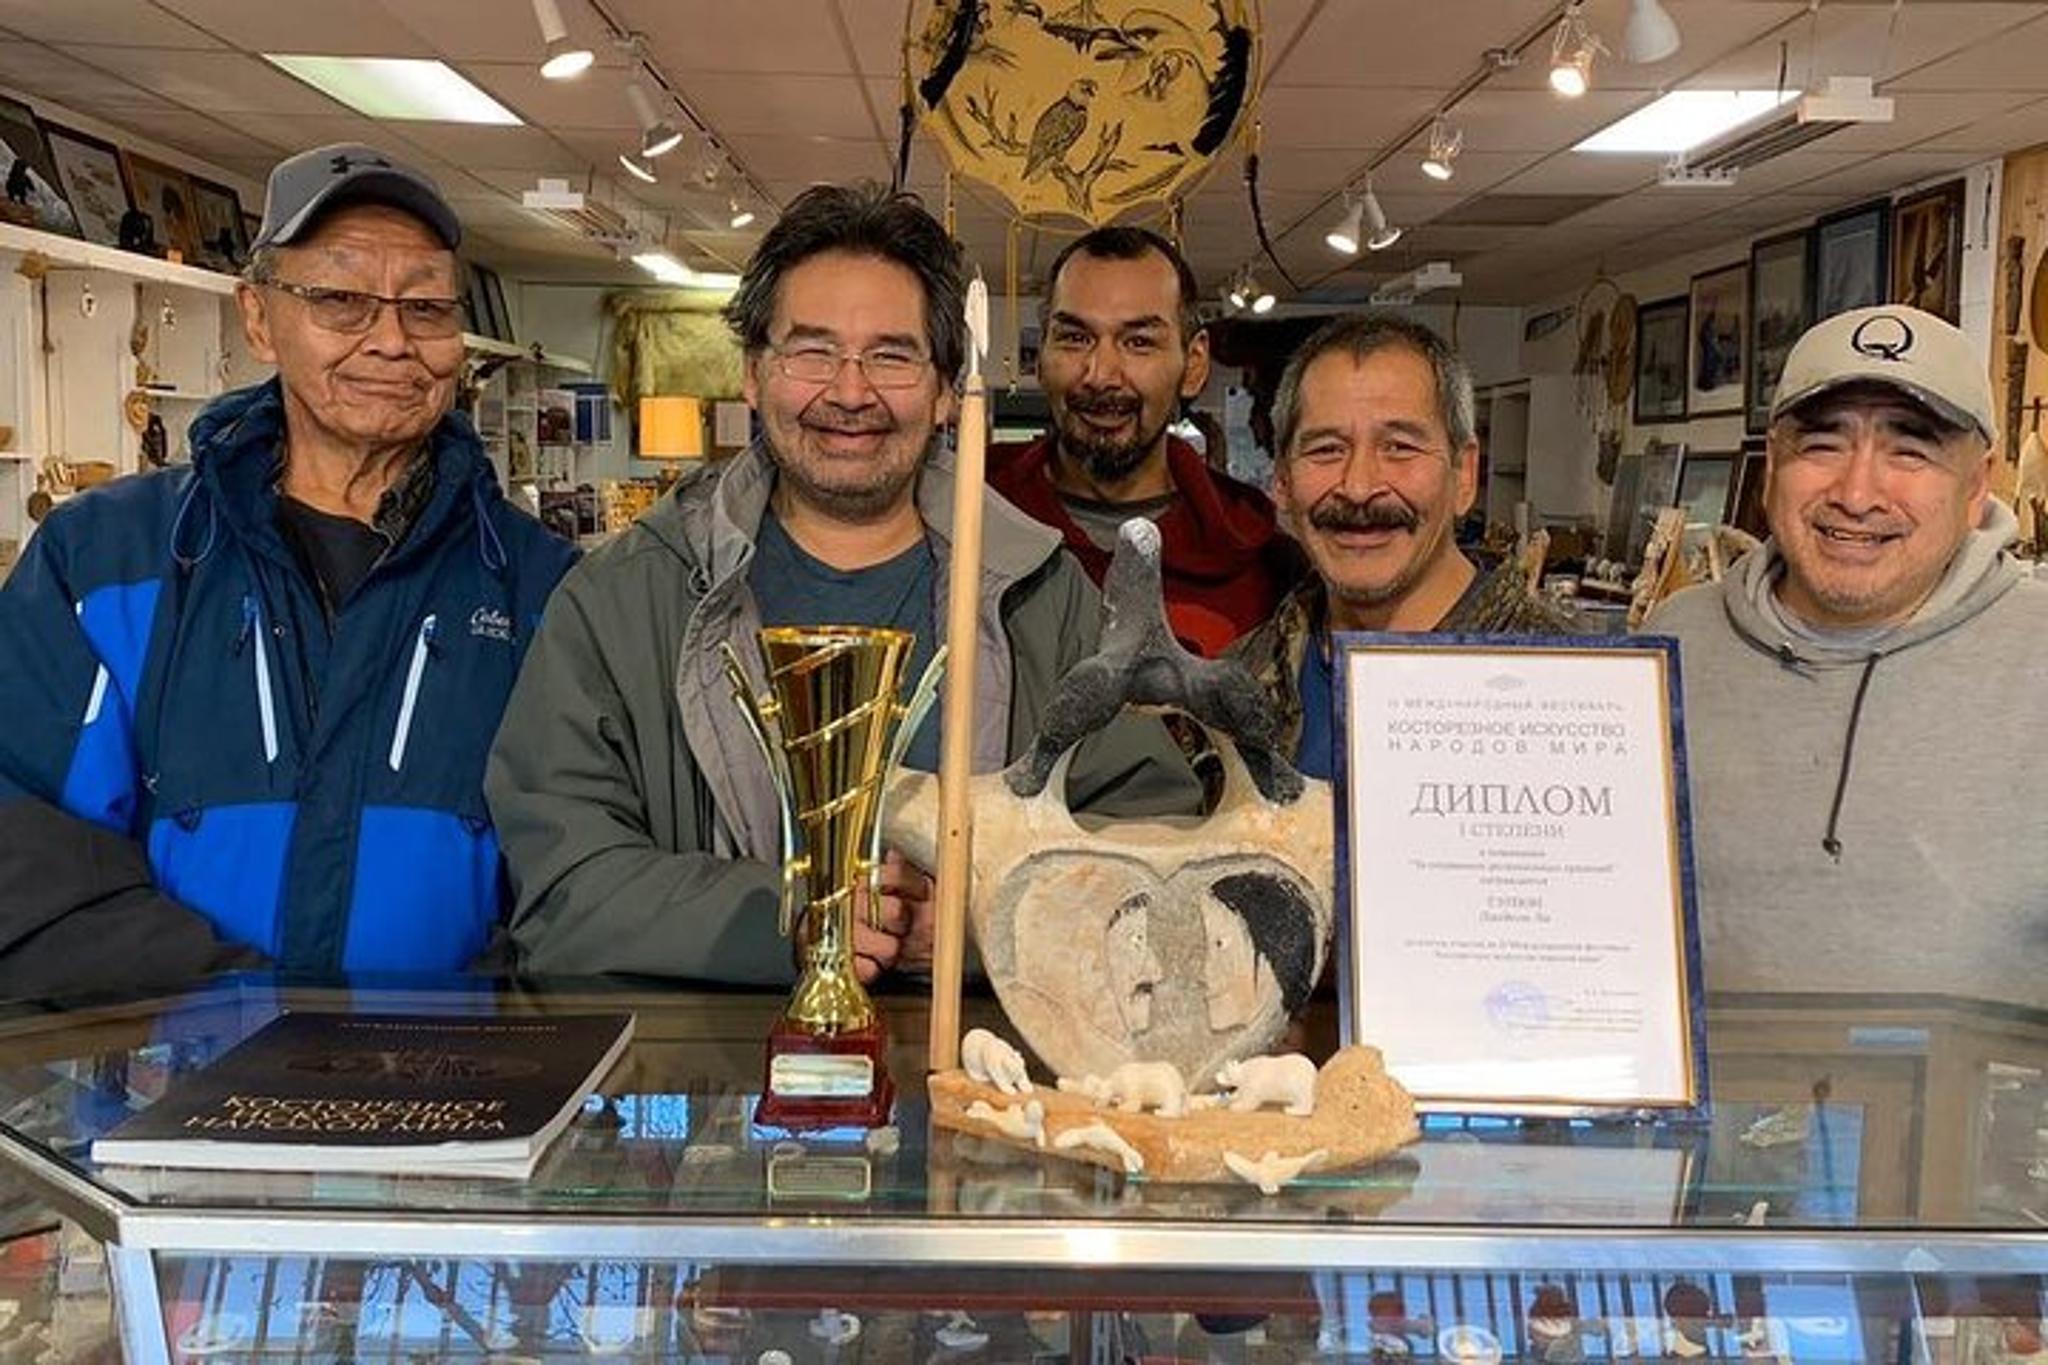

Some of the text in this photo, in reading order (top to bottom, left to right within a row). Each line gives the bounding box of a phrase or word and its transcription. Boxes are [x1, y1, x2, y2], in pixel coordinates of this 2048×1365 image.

[1388, 720, 1626, 737] КОСТОРЕЗНОЕ ИСКУССТВО
[1388, 738, 1628, 755] НАРОДОВ МИРА
[1410, 782, 1613, 817] ДИПЛОМ
